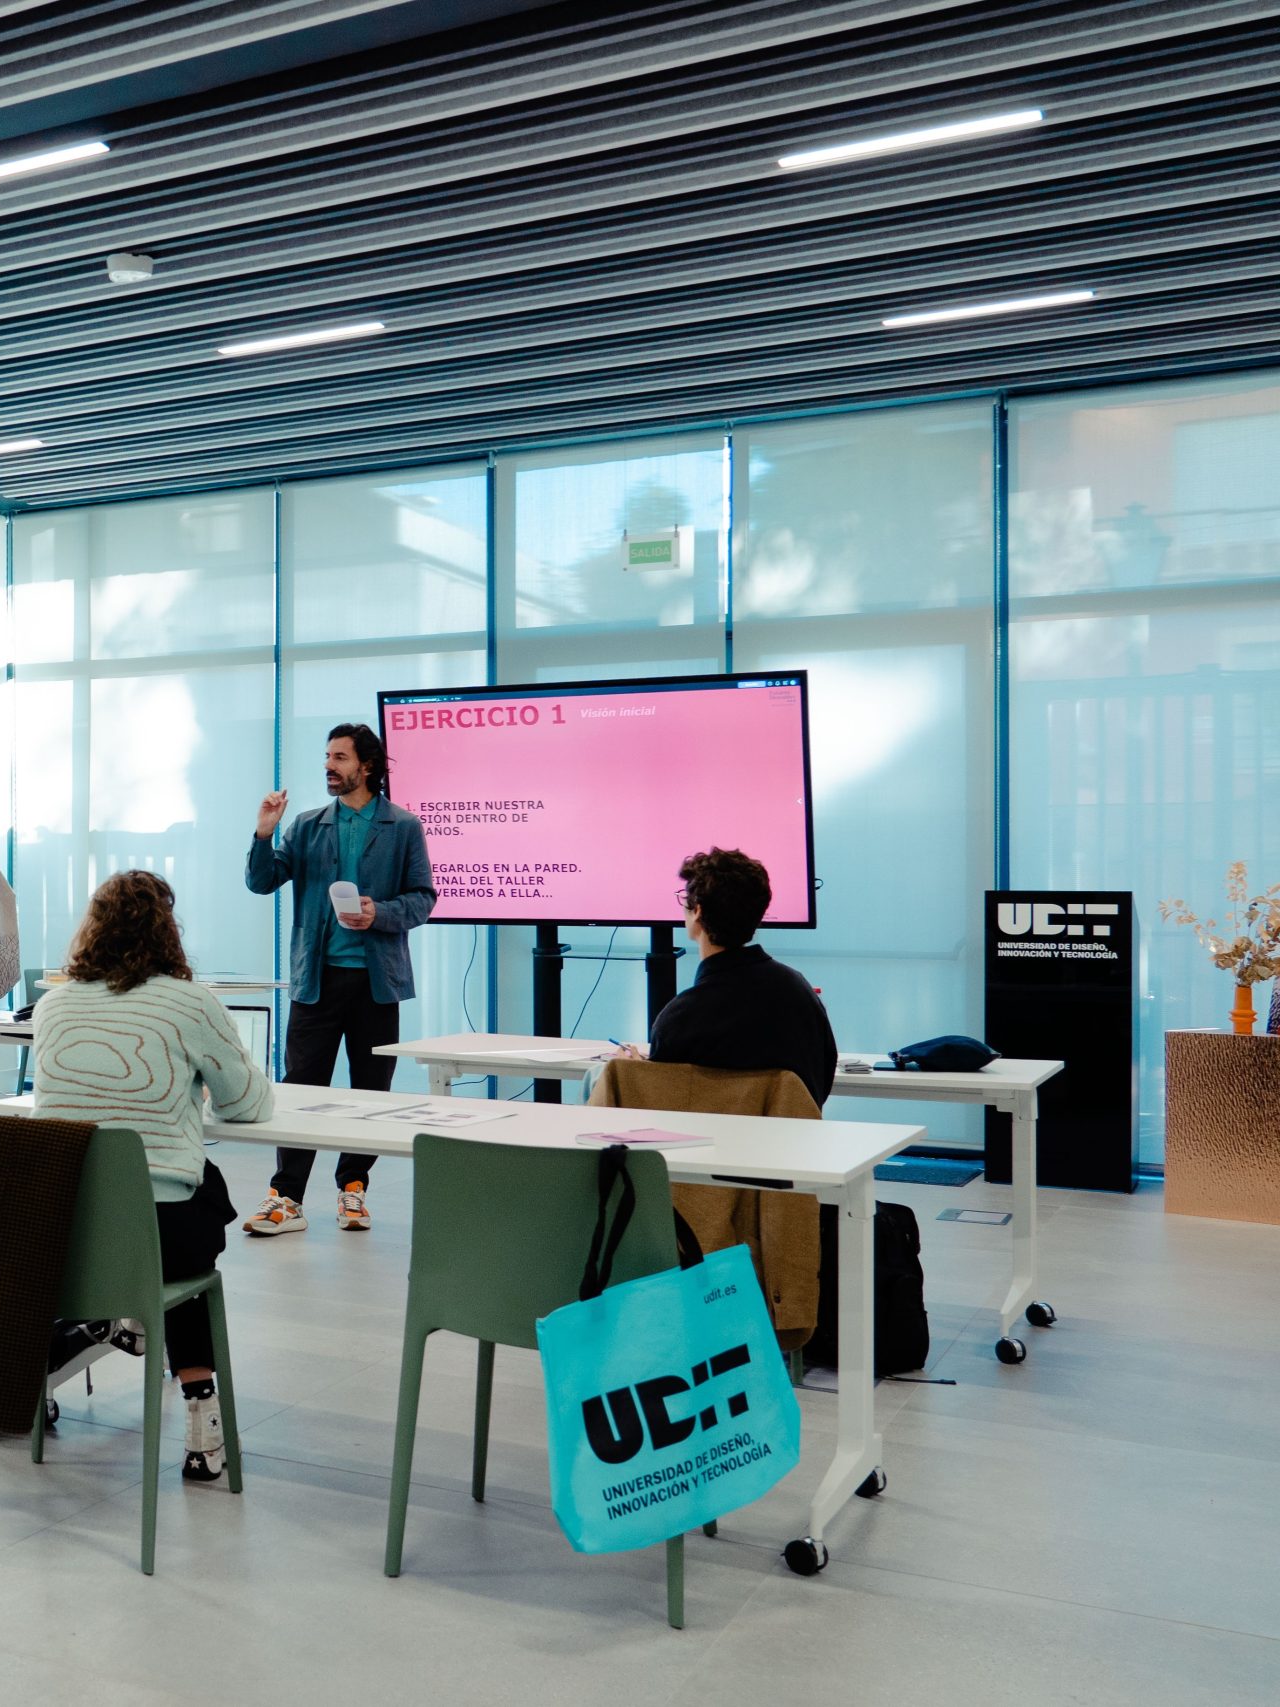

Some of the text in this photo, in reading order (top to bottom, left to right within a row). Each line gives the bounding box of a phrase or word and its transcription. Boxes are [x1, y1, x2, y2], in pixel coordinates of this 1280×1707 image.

[631, 547, 670, 558] SALIDA
[391, 704, 566, 731] EJERCICIO 1
[580, 705, 656, 719] Visión inicial
[420, 801, 481, 812] ESCRIBIR
[485, 800, 545, 811] NUESTRA
[418, 812, 529, 824] SIÓN DENTRO DE
[426, 824, 464, 836] AÑOS.
[432, 863, 582, 873] EGARLOS EN LA PARED.
[432, 876, 545, 886] INAL DEL TALLER
[437, 888, 553, 898] VEREMOS A ELLA...
[997, 903, 1119, 936] UDIT
[997, 942, 1108, 952] UNIVERSIDAD DE DISEÑO,
[997, 949, 1052, 957] INNOVACIÓN
[1062, 950, 1118, 959] TECNOLOGÍA
[704, 1284, 738, 1305] udit.es
[581, 1343, 751, 1465] UDIT
[602, 1431, 756, 1502] UNIVERSIDAD DE DISEÑO,
[607, 1442, 772, 1520] INNOVACIÓN Y TECNOLOGÍA
